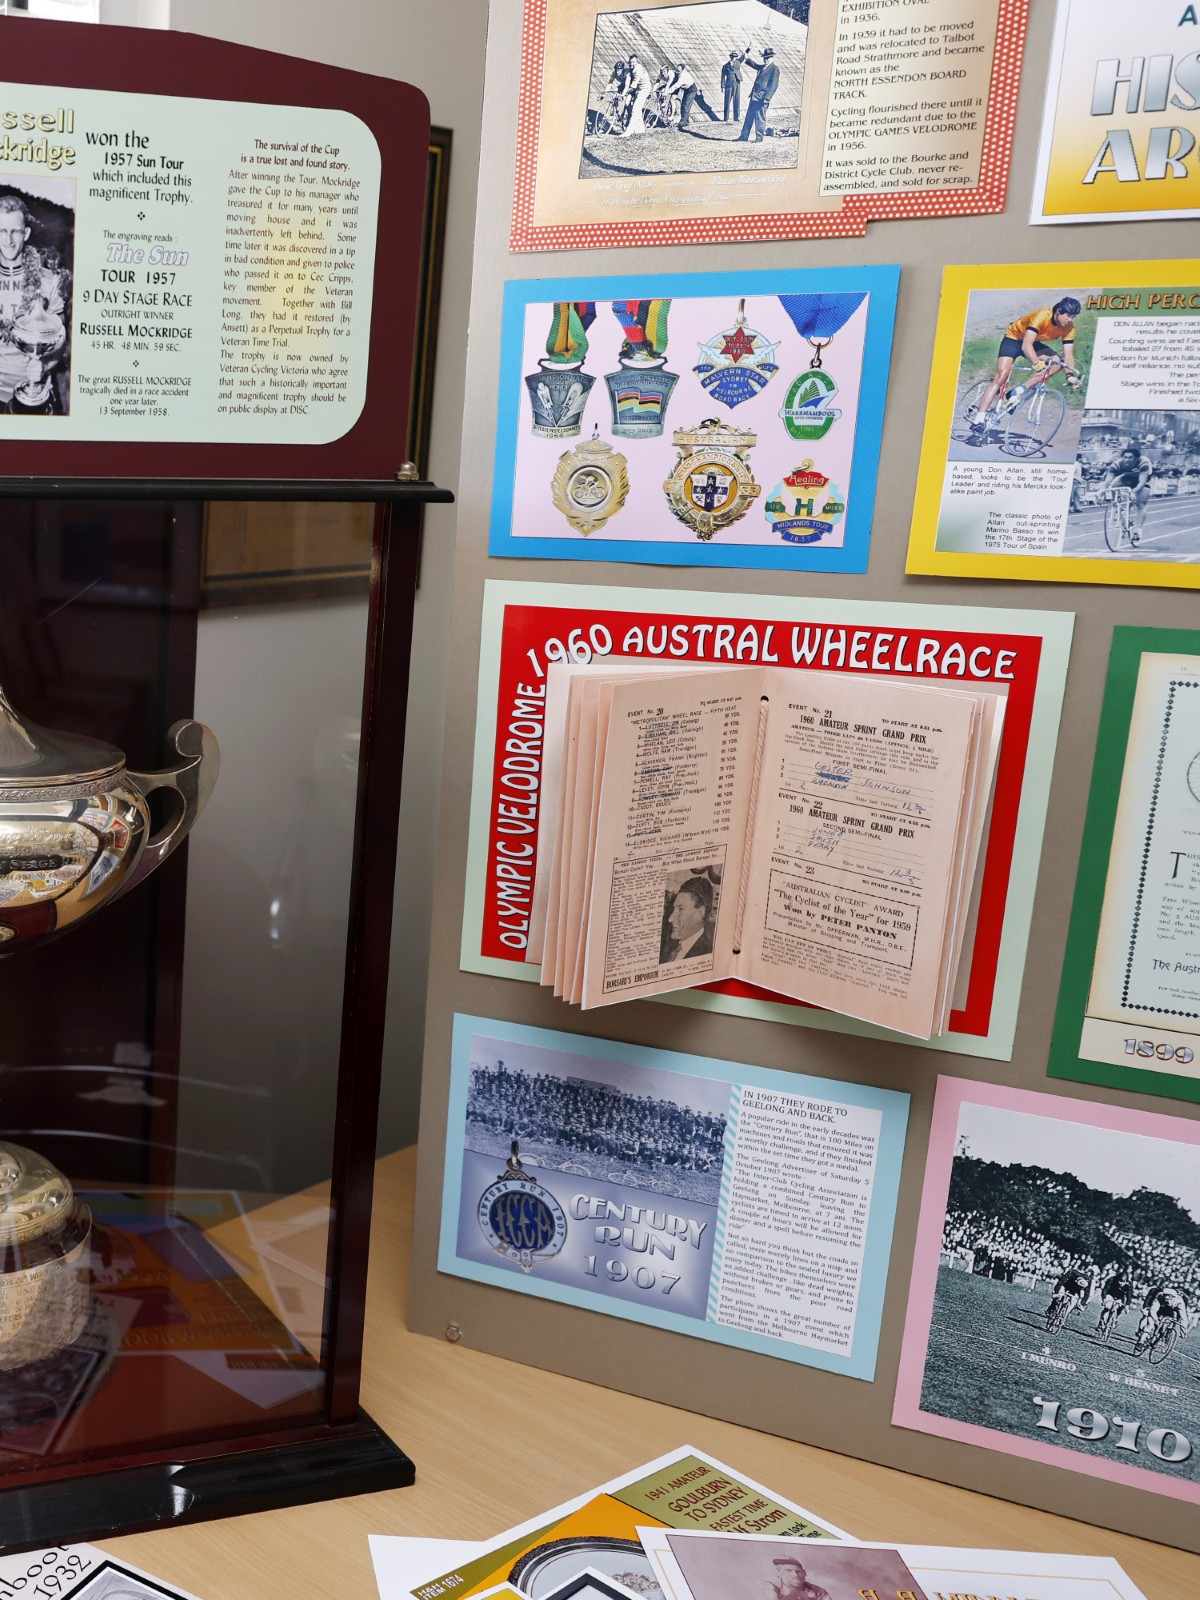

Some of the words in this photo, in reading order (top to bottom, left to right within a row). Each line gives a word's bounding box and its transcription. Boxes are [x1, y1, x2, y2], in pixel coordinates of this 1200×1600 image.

[833, 77, 868, 88] NORTH
[871, 73, 926, 85] ESSENDON
[929, 69, 966, 80] BOARD
[85, 132, 118, 146] won
[124, 130, 149, 149] the
[828, 129, 871, 139] OLYMPIC
[874, 126, 910, 136] GAMES
[912, 121, 977, 133] VELODROME
[254, 138, 268, 150] The
[270, 142, 298, 151] survival
[300, 143, 309, 152] of
[310, 143, 322, 154] the
[324, 144, 340, 155] Cup
[827, 143, 836, 151] in
[840, 141, 866, 150] 1956.
[104, 152, 132, 166] 1957
[136, 154, 156, 168] Sun
[160, 155, 184, 170] Tour
[240, 153, 247, 163] is
[256, 155, 272, 165] true
[273, 155, 287, 166] lost
[289, 157, 304, 167] and
[305, 157, 327, 168] found
[329, 161, 349, 172] story.
[92, 169, 123, 182] which
[127, 171, 170, 185] included
[173, 173, 192, 186] this
[89, 187, 150, 201] magnificent
[155, 188, 192, 205] Trophy.
[103, 229, 116, 239] The
[117, 233, 152, 243] engraving
[154, 233, 172, 242] reads
[106, 243, 144, 264] The
[148, 245, 189, 266] Sun
[100, 269, 135, 283] TOUR
[146, 271, 176, 285] 1957
[82, 290, 90, 302] 9
[94, 288, 119, 303] DAY
[122, 290, 158, 305] STAGE
[162, 292, 192, 307] RACE
[1087, 295, 1141, 310] HIGH
[100, 309, 141, 319] OUTRIGHT
[142, 311, 174, 320] WINNER
[80, 322, 123, 336] RUSSELL
[127, 324, 192, 338] MOCKRIDGE
[704, 368, 742, 385] MALVERN
[745, 371, 766, 385] STAR
[789, 471, 824, 485] Healing
[777, 519, 810, 529] MIDLANDS
[812, 521, 829, 530] TOUR
[526, 623, 613, 679] 1960
[622, 625, 780, 664] AUSTRAL
[790, 625, 1017, 680] WHEELRACE
[789, 704, 807, 712] EVENT
[824, 710, 832, 718] 21
[800, 715, 814, 725] 1960
[819, 718, 849, 732] AMATEUR
[854, 724, 877, 735] SPRINT
[882, 728, 905, 740] GRAND
[911, 734, 927, 744] PRIX
[497, 682, 546, 835] VELODROME
[496, 840, 533, 950] OLYMPIC
[784, 904, 802, 915] Won
[807, 910, 816, 919] by
[821, 914, 851, 928] PETER
[856, 924, 897, 939] PANTON
[795, 895, 820, 909] Cyclist
[834, 906, 846, 915] the
[876, 916, 888, 925] for
[892, 920, 911, 931] 1959
[1124, 1038, 1194, 1064] 1899
[742, 1099, 785, 1114] GEELONG
[787, 1109, 807, 1118] AND
[810, 1112, 836, 1124] BACK.
[757, 1093, 777, 1103] 1907
[781, 1097, 805, 1108] THEY
[807, 1102, 832, 1114] RODE
[835, 1107, 848, 1116] TO
[483, 1183, 508, 1226] CENTURY
[520, 1183, 546, 1198] RUN
[553, 1206, 565, 1237] 1907
[569, 1193, 708, 1249] CENTURY
[593, 1225, 676, 1260] RUN
[584, 1254, 681, 1295] 1907
[1033, 1396, 1193, 1462] 1910
[646, 1488, 670, 1502] 1941
[669, 1466, 711, 1490] AMATEUR
[668, 1477, 733, 1513] GOULBURN
[684, 1509, 708, 1522] TO
[708, 1486, 749, 1514] SYDNEY
[709, 1511, 743, 1532] FASTEST
[742, 1498, 769, 1517] TIME
[747, 1509, 788, 1533] Strom
[33, 1554, 91, 1599] 1932
